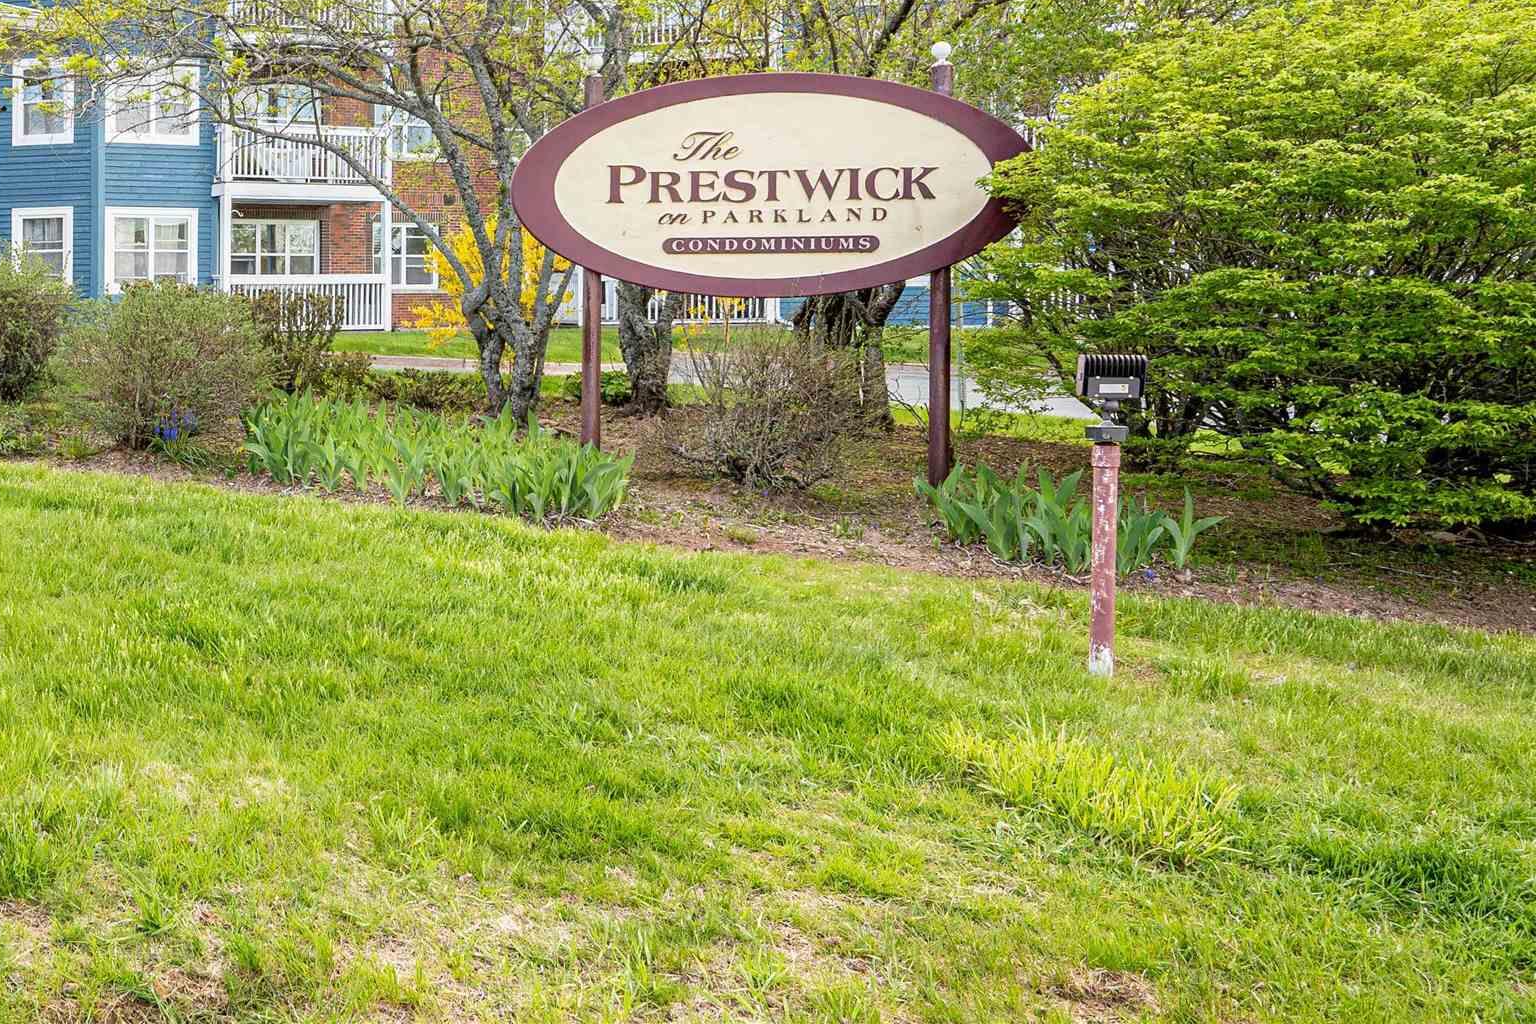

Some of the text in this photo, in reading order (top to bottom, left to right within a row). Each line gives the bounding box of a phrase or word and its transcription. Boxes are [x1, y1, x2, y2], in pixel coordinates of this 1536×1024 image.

[672, 131, 744, 161] The
[605, 164, 939, 205] PRESTWICK
[658, 207, 888, 225] on PARKLAND
[671, 236, 872, 252] CONDOMINIUMS
